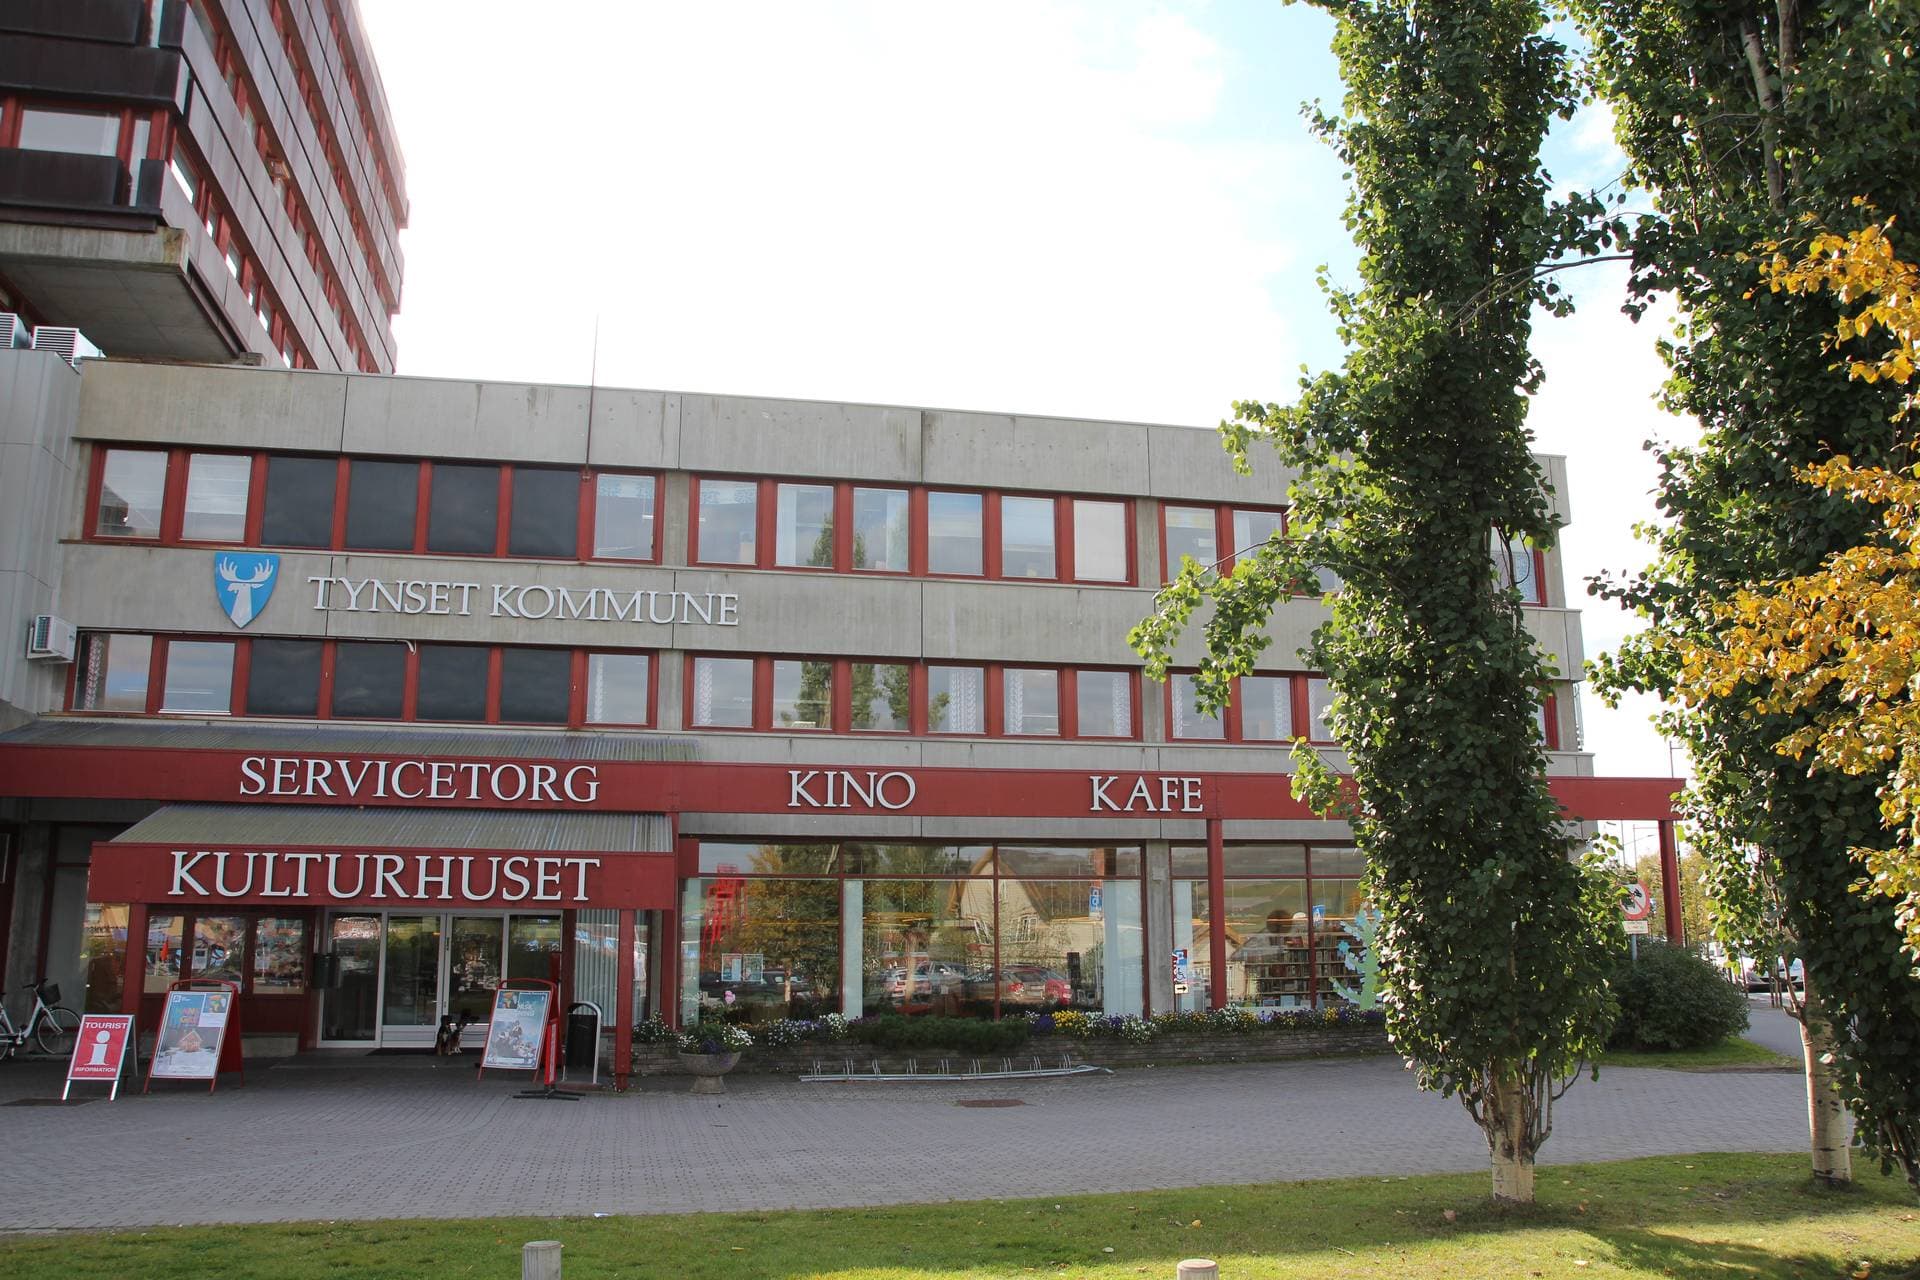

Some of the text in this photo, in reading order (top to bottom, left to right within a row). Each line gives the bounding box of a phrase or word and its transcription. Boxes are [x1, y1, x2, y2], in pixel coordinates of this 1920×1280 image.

[307, 576, 740, 626] TYNSET KOMMUNE
[239, 757, 600, 802] SERVICETORG
[787, 770, 916, 810] KINO
[1089, 775, 1204, 813] KAFE
[167, 850, 601, 901] KULTURHUSET
